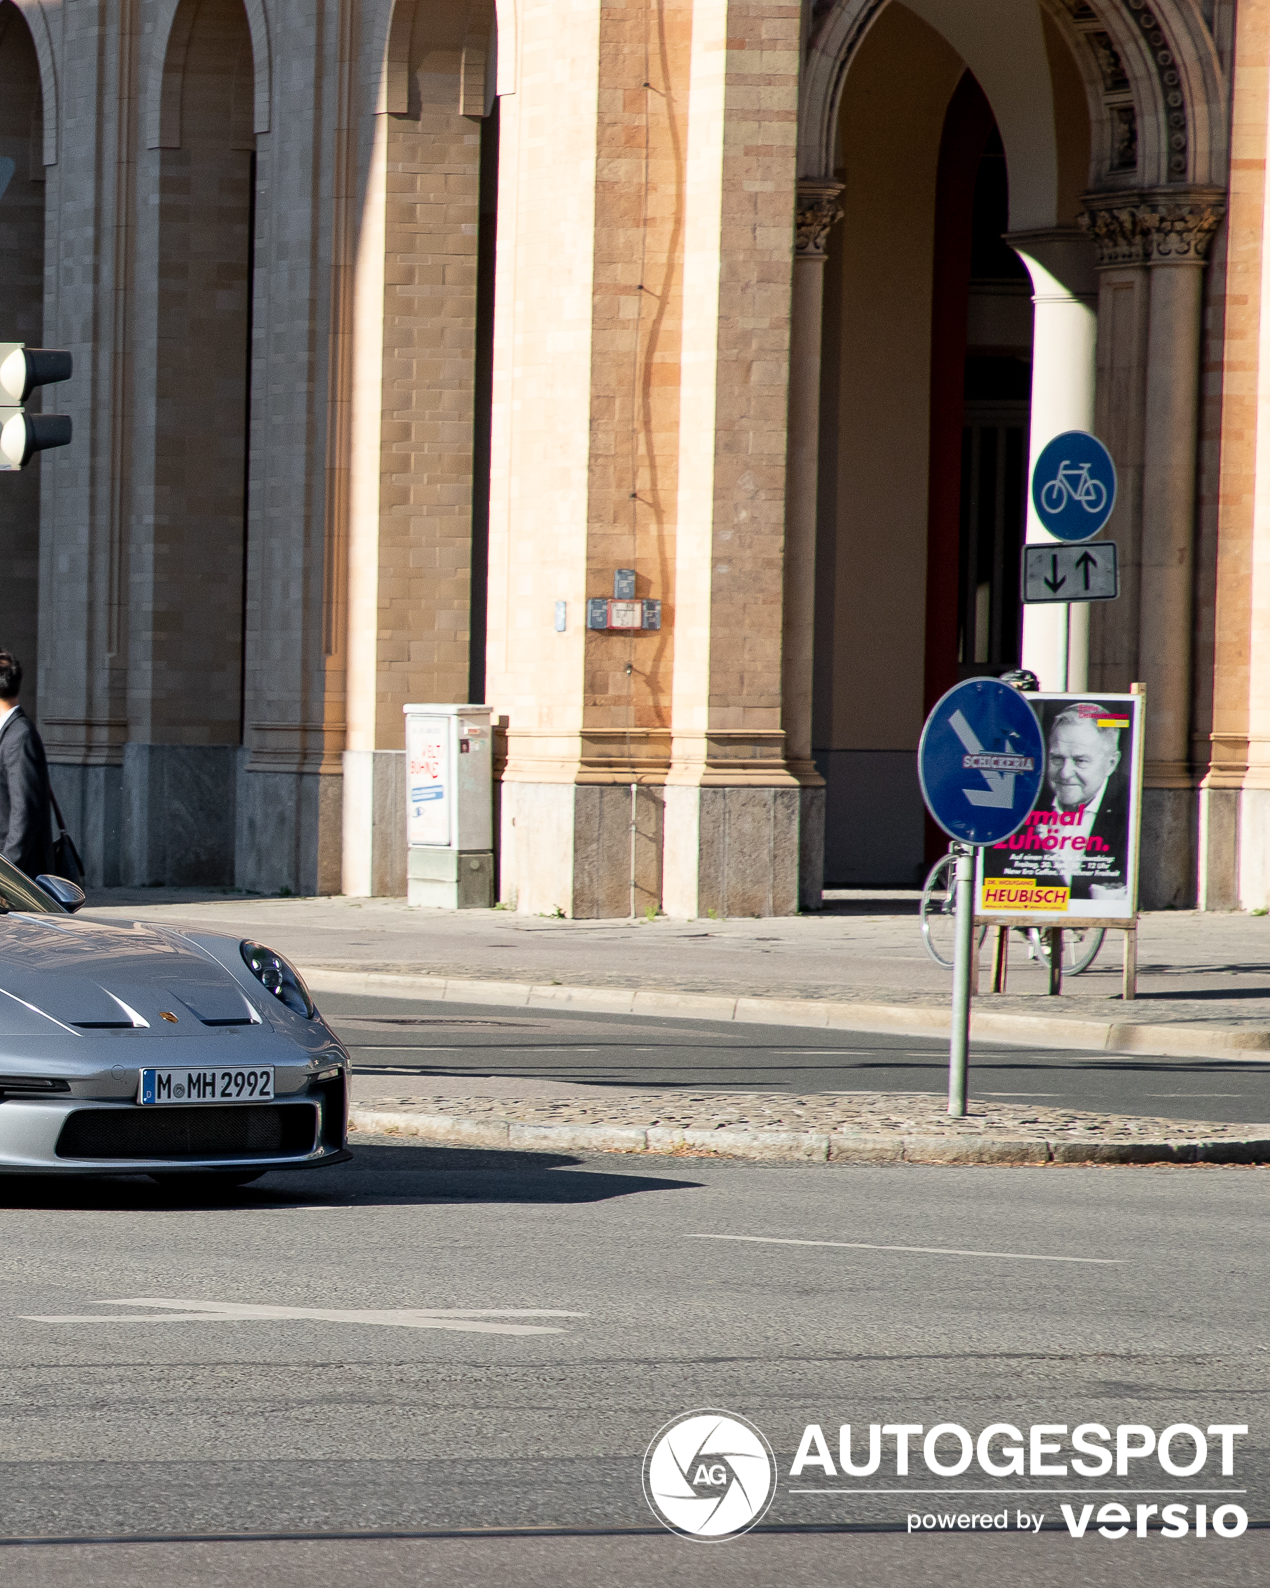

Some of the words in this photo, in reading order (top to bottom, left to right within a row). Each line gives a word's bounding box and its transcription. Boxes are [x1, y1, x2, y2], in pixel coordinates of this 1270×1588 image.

[964, 755, 1034, 770] SCHICKERIA
[985, 889, 1067, 903] HEUBISCH
[157, 1074, 171, 1099] M
[188, 1072, 216, 1098] MH
[221, 1071, 271, 1097] 2992
